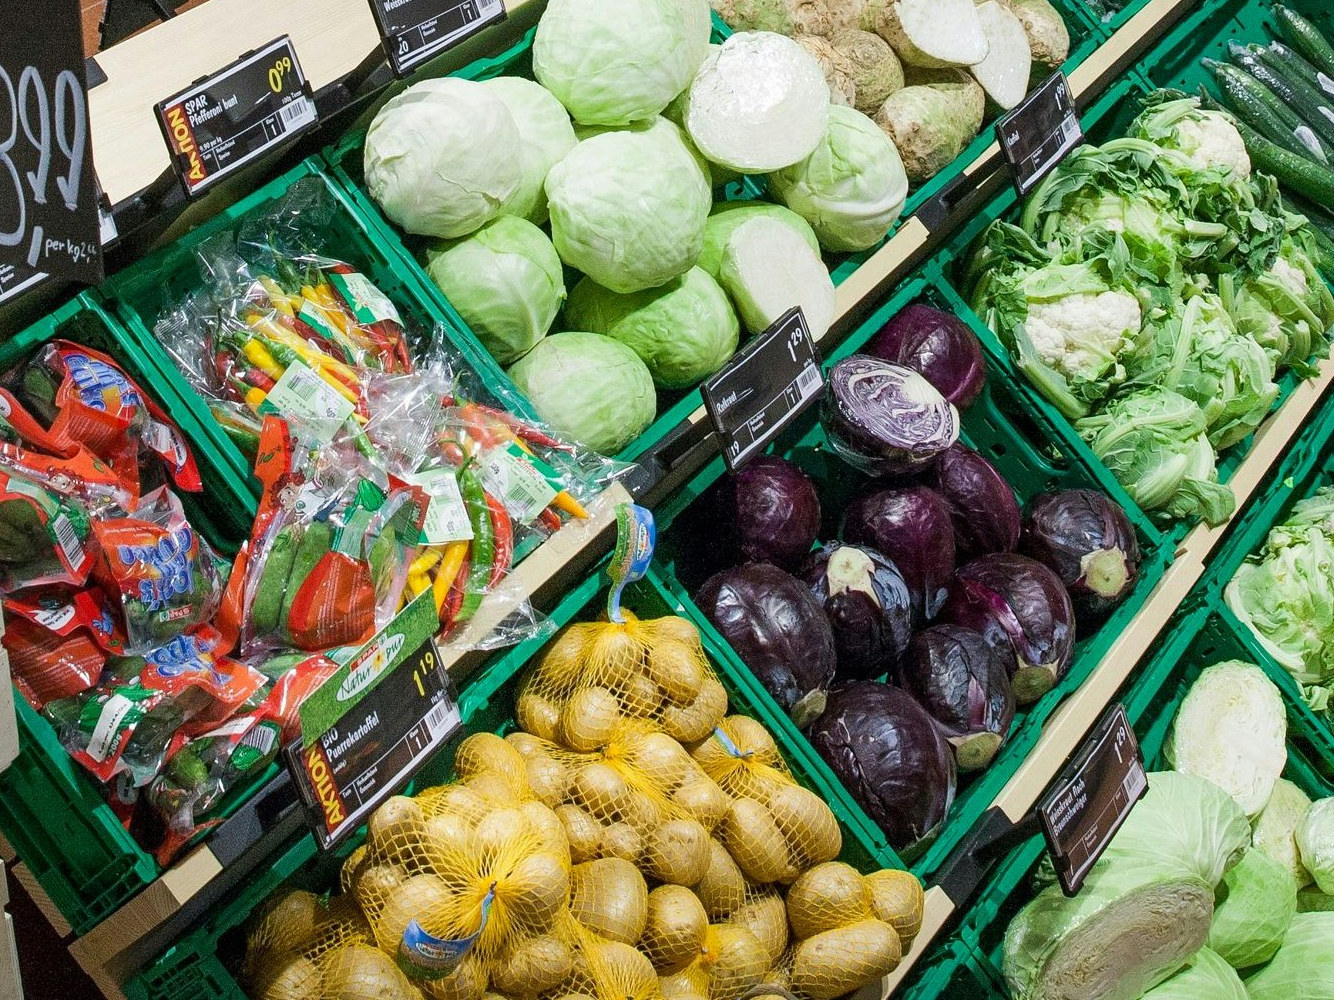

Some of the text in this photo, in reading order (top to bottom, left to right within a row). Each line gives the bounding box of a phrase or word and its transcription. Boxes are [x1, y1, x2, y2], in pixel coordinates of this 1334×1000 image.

[185, 94, 208, 115] SPAR
[188, 94, 238, 128] Pfefferoni bunt
[45, 237, 66, 258] per
[67, 241, 80, 263] kg
[168, 606, 191, 620] SPAR
[340, 636, 404, 698] Natur pur
[110, 735, 123, 756] 200g
[322, 727, 339, 750] BIO
[307, 744, 344, 826] AKTION
